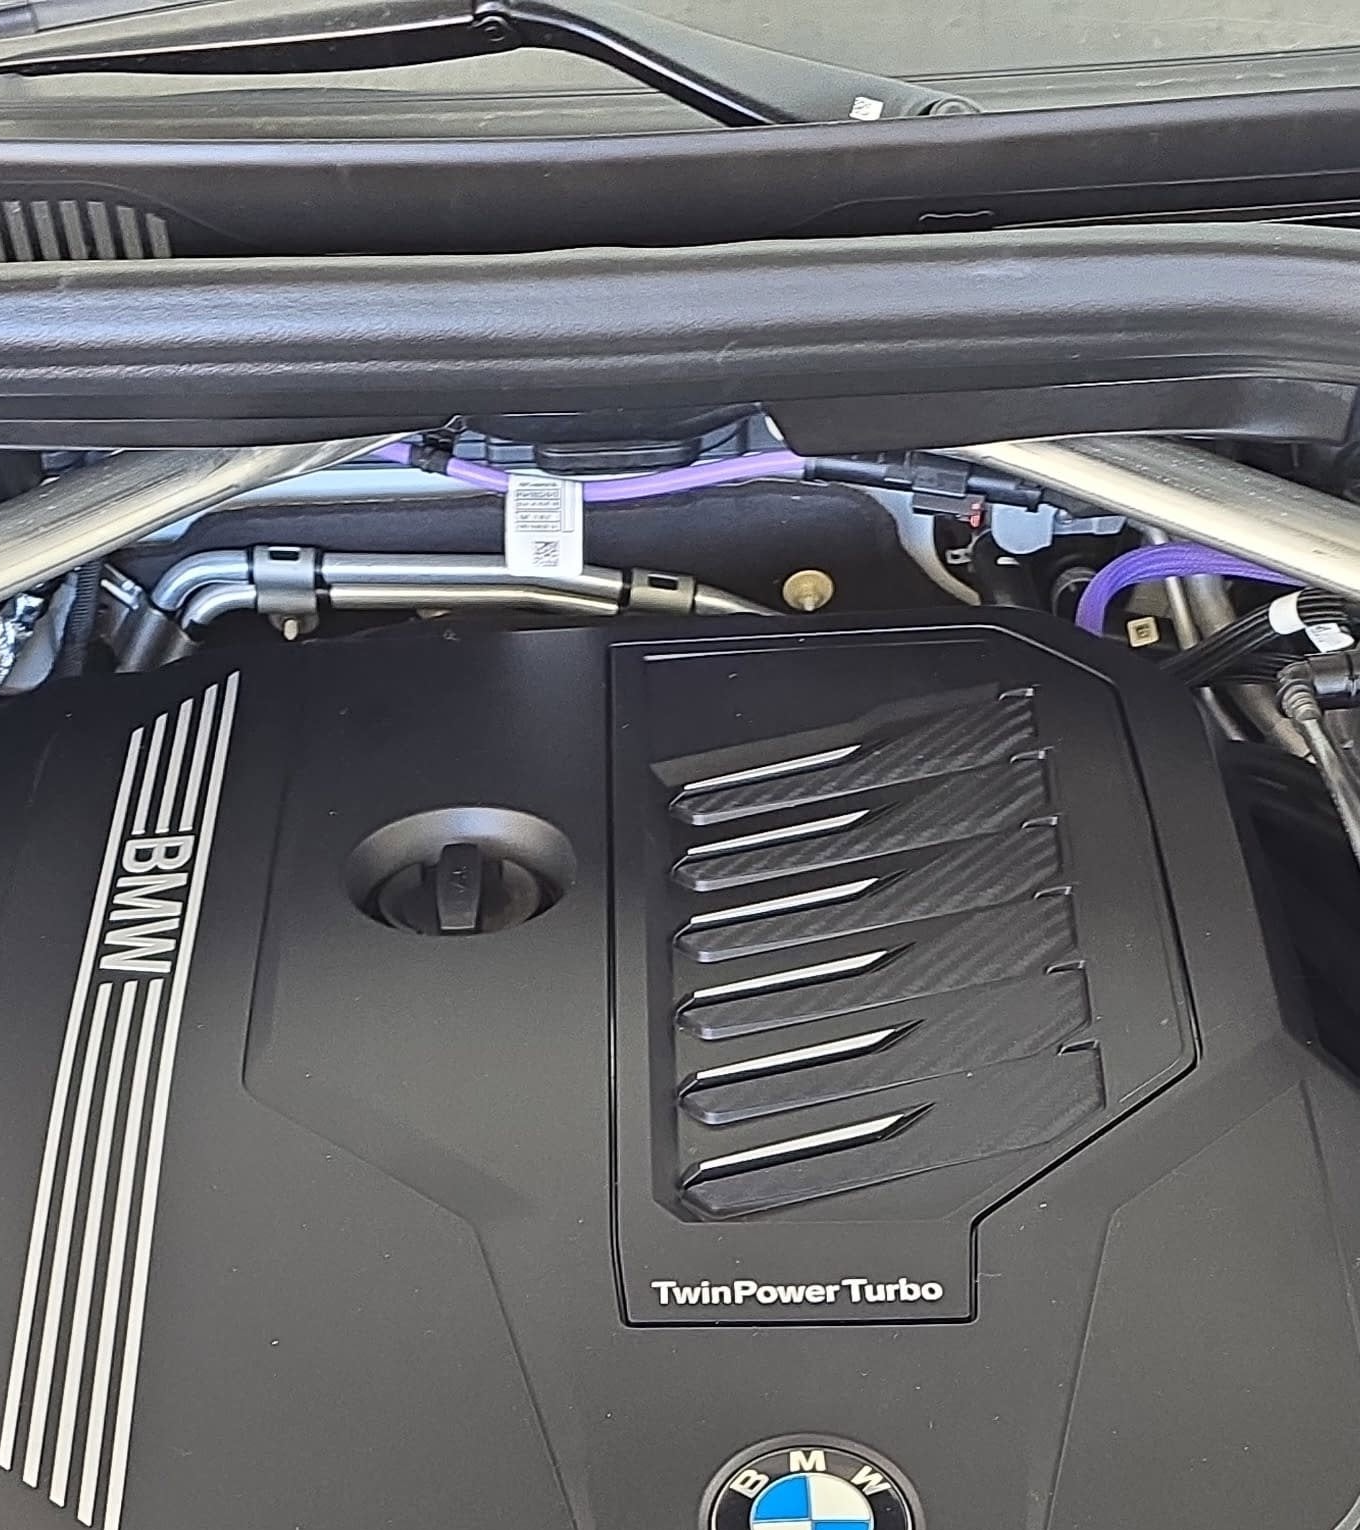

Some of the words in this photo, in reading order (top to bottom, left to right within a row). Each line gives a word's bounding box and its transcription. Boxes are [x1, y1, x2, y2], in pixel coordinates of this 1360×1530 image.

[99, 835, 195, 973] BMW
[841, 1277, 944, 1303] Turbo
[729, 1449, 891, 1499] BMW
